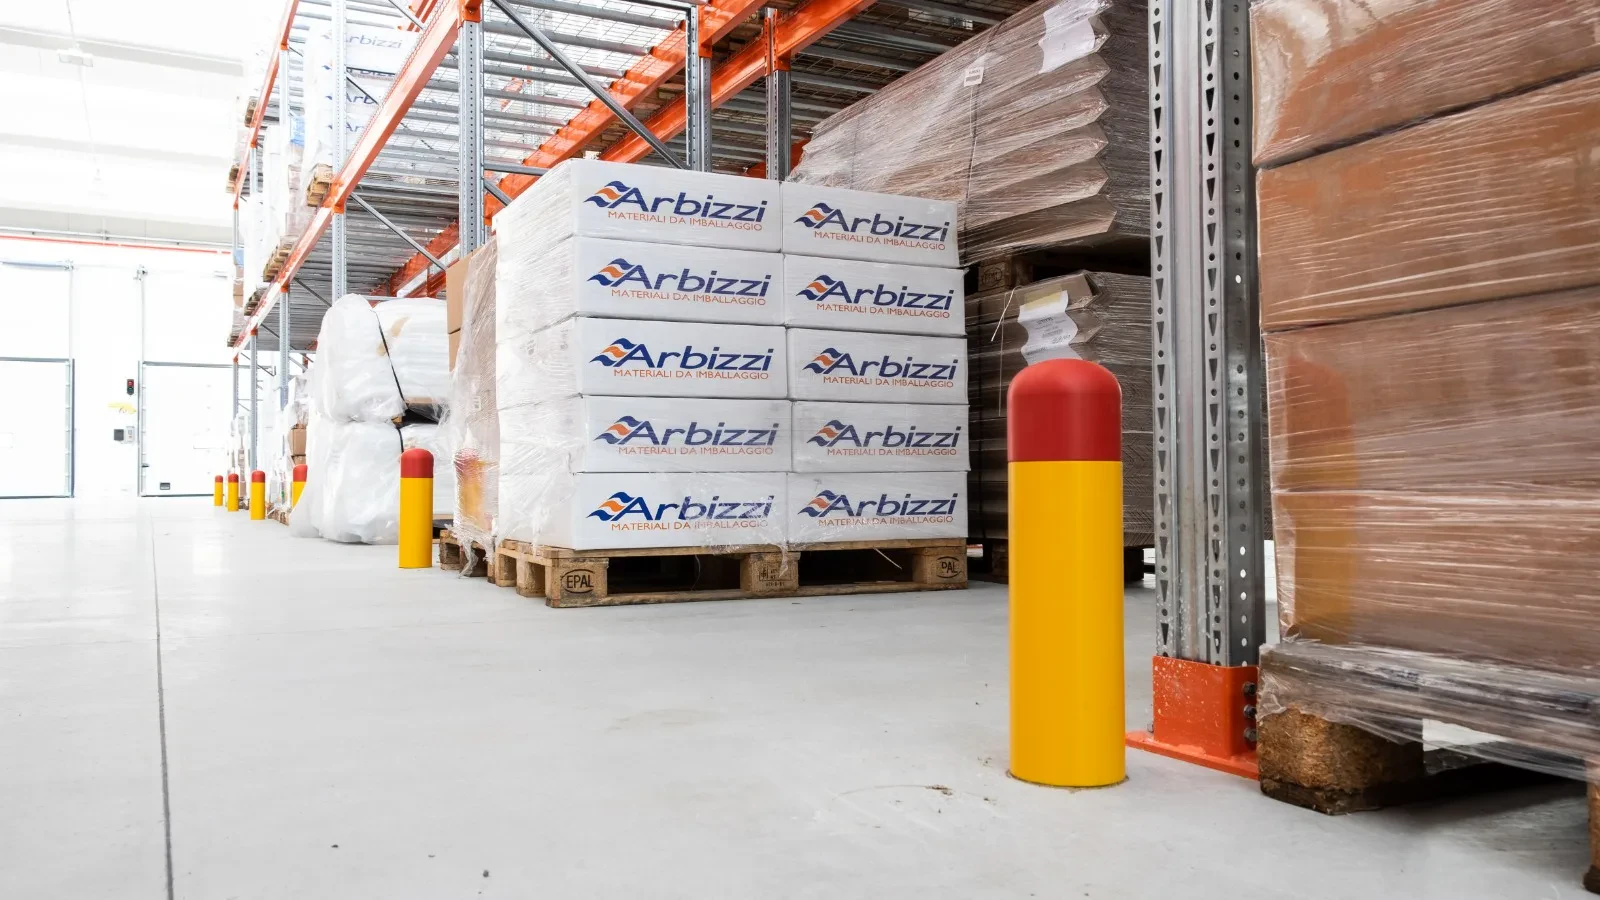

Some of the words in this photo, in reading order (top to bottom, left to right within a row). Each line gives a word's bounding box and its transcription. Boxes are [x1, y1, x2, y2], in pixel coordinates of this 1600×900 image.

[344, 34, 403, 49] rbizzi
[607, 187, 768, 223] Arbizzi
[608, 211, 666, 223] MATERIALI
[669, 216, 686, 225] DA
[689, 217, 763, 232] IMBALLAGGIO
[814, 209, 950, 242] Arbizzi
[814, 231, 864, 243] MATERIALI
[867, 236, 880, 244] DA
[883, 237, 946, 251] IMBALLAGGIO
[610, 264, 772, 297] Arbizzi
[611, 289, 670, 300] MATERIALI
[673, 294, 690, 302] DA
[693, 294, 767, 306] IMBALLAGGIO
[816, 280, 954, 311] Arbizzi
[816, 303, 867, 314] MATERIALI
[870, 307, 884, 315] DA
[887, 308, 950, 319] IMBALLAGGIO
[612, 343, 774, 372] Arbizzi
[823, 353, 959, 380] Arbizzi
[613, 369, 672, 378] MATERIALI
[675, 371, 692, 379] DA
[696, 371, 769, 380] IMBALLAGGIO
[823, 376, 873, 385] MATERIALI
[875, 378, 889, 386] DA
[892, 378, 954, 388] IMBALLAGGIO
[617, 420, 780, 446] Arbizzi
[826, 424, 962, 448] Arbizzi
[618, 447, 677, 455] MATERIALI
[680, 447, 697, 455] DA
[700, 447, 774, 456] IMBALLAGGIO
[827, 448, 876, 456] MATERIALI
[879, 448, 893, 456] DA
[895, 448, 957, 456] IMBALLAGGIO
[610, 495, 775, 522] Arbizzi
[818, 493, 959, 518] Arbizzi
[611, 522, 670, 531] MATERIALI
[674, 522, 691, 530] DA
[872, 517, 887, 525] DA
[889, 515, 954, 525] IMBALLAGGIO
[566, 574, 594, 589] EPAL
